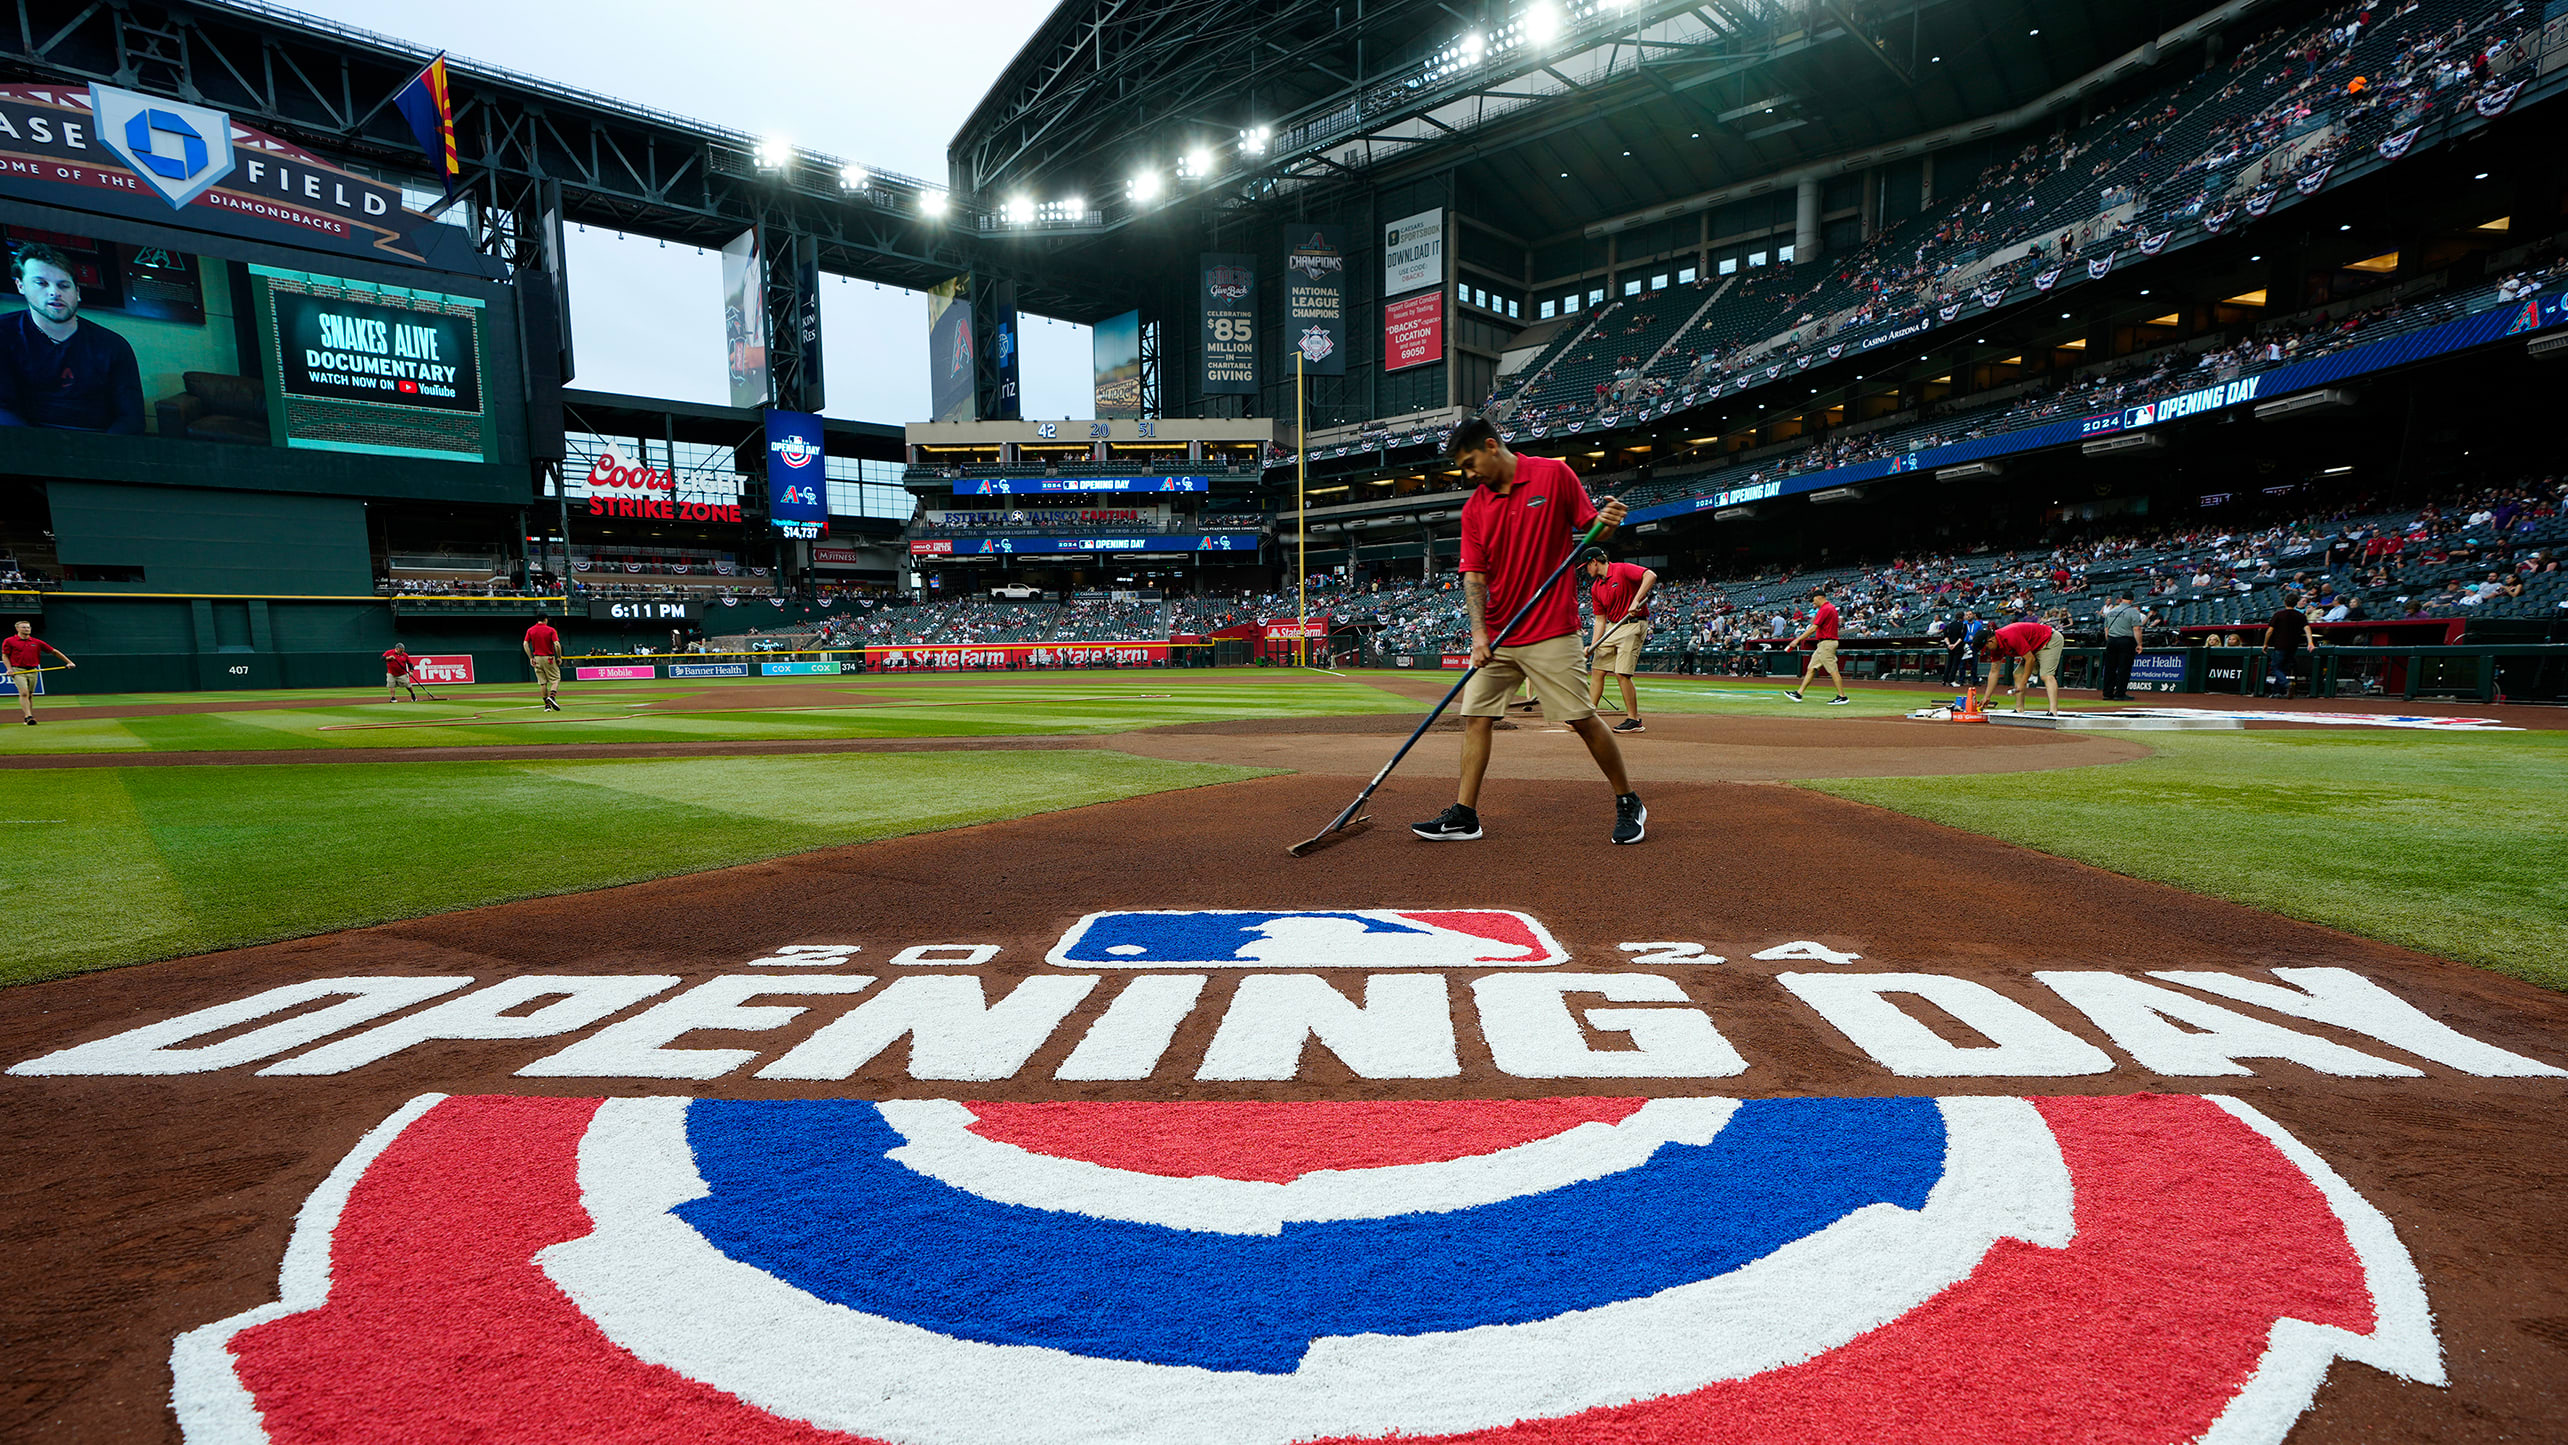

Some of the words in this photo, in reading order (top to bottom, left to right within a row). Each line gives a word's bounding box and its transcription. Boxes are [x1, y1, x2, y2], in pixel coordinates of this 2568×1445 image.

[247, 160, 387, 216] FIELD
[57, 168, 82, 180] OF
[98, 174, 137, 189] THE
[210, 193, 342, 233] DIAMONDBACKS
[1400, 222, 1424, 233] CAESARS
[1400, 224, 1440, 243] SPORTSBOOK
[1387, 243, 1429, 268] DOWNLOAD
[1432, 240, 1440, 256] IT
[1289, 255, 1342, 271] CHAMPIONS
[1399, 267, 1409, 275] USE
[1402, 271, 1425, 282] DBACKS
[1210, 284, 1228, 297] Give
[1226, 285, 1248, 298] Back
[1292, 287, 1339, 296] NATIONAL
[1292, 298, 1340, 308] LEAGUE
[1388, 303, 1403, 313] Report
[1404, 300, 1418, 309] Guest
[1419, 294, 1440, 304] Conduct
[1417, 304, 1434, 313] Texting
[1292, 308, 1340, 319] CHAMPIONS
[1207, 318, 1253, 342] $85
[1395, 327, 1431, 344] LOCATION
[1862, 335, 1887, 348] CASINO
[1888, 324, 1920, 341] ARIZONA
[318, 313, 388, 355] SNAKES
[395, 323, 440, 361] ALIVE
[1207, 343, 1253, 353] MILLION
[1401, 346, 1426, 359] 69050
[306, 349, 456, 383] DOCUMENTARY
[1208, 370, 1253, 381] GIVING
[308, 371, 349, 386] WATCH
[352, 376, 377, 389] NOW
[380, 379, 395, 391] ON
[418, 383, 456, 398] YouTube
[2083, 417, 2119, 432] 2024
[2157, 385, 2225, 422] OPENING
[2226, 376, 2261, 405] DAY
[1038, 423, 1056, 438] 42
[1089, 423, 1110, 438] 20
[1138, 422, 1156, 437] 51
[771, 442, 804, 453] OPENING
[806, 445, 821, 455] DAY
[587, 453, 675, 491] Coors
[677, 470, 748, 496] LIGHT
[1080, 480, 1114, 489] OPENING
[1115, 480, 1130, 489] DAY
[1696, 498, 1713, 508] 2024
[1730, 484, 1764, 504] OPENING
[1764, 481, 1781, 498] DAY
[589, 496, 675, 520] STRIKE
[679, 501, 742, 523] ZONE
[945, 513, 1008, 523] ESTRELLA
[1026, 511, 1078, 523] JALISCO
[1081, 510, 1138, 521] CANTINA
[783, 526, 818, 539] $14,737
[1095, 540, 1129, 549] OPENING
[1130, 540, 1146, 549] DAY
[611, 603, 652, 618] 6:11
[660, 603, 685, 618] PM
[811, 664, 830, 672] COX
[842, 664, 856, 672] 374
[2152, 656, 2182, 668] Health
[229, 666, 249, 675] 407
[414, 658, 468, 680] fry's
[607, 668, 633, 677] Mobile
[684, 666, 713, 676] Banner
[714, 665, 743, 675] Health
[772, 665, 791, 673] COX
[2209, 668, 2242, 679] AVNET
[4, 972, 1749, 1081] OPENING
[1775, 967, 2568, 1079] DAY
